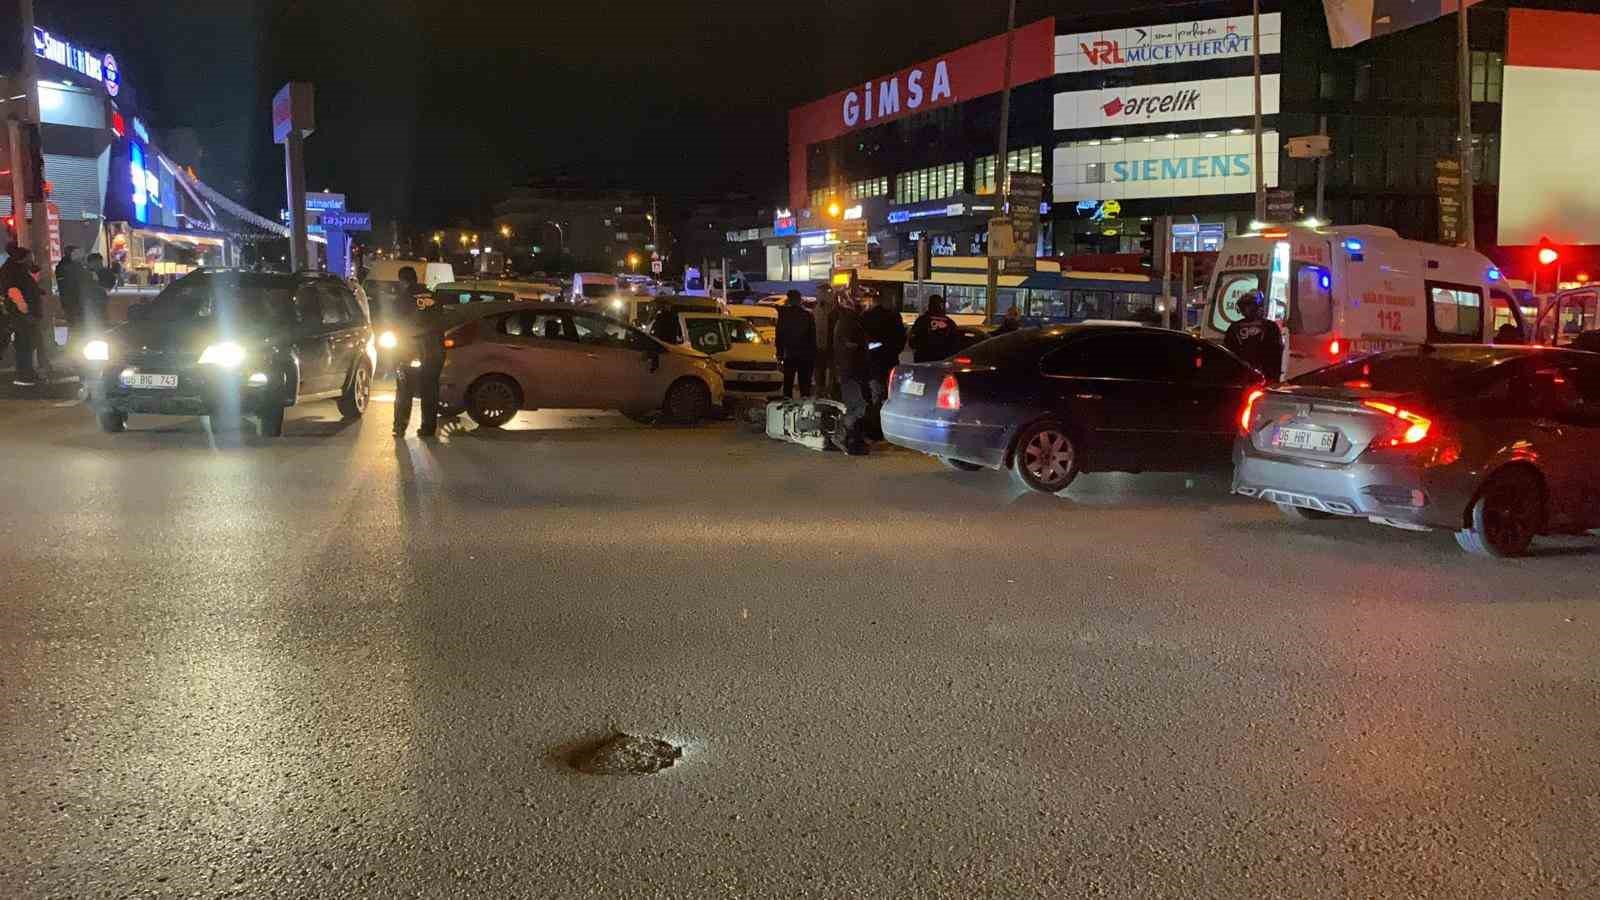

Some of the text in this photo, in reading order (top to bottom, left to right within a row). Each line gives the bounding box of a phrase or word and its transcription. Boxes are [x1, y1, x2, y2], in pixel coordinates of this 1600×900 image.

[1080, 40, 1125, 65] VRL
[843, 60, 951, 126] GİMSA
[1124, 88, 1201, 119] arçelik
[1113, 153, 1250, 182] SIEMENS
[1377, 309, 1402, 332] 112
[160, 375, 177, 386] 743
